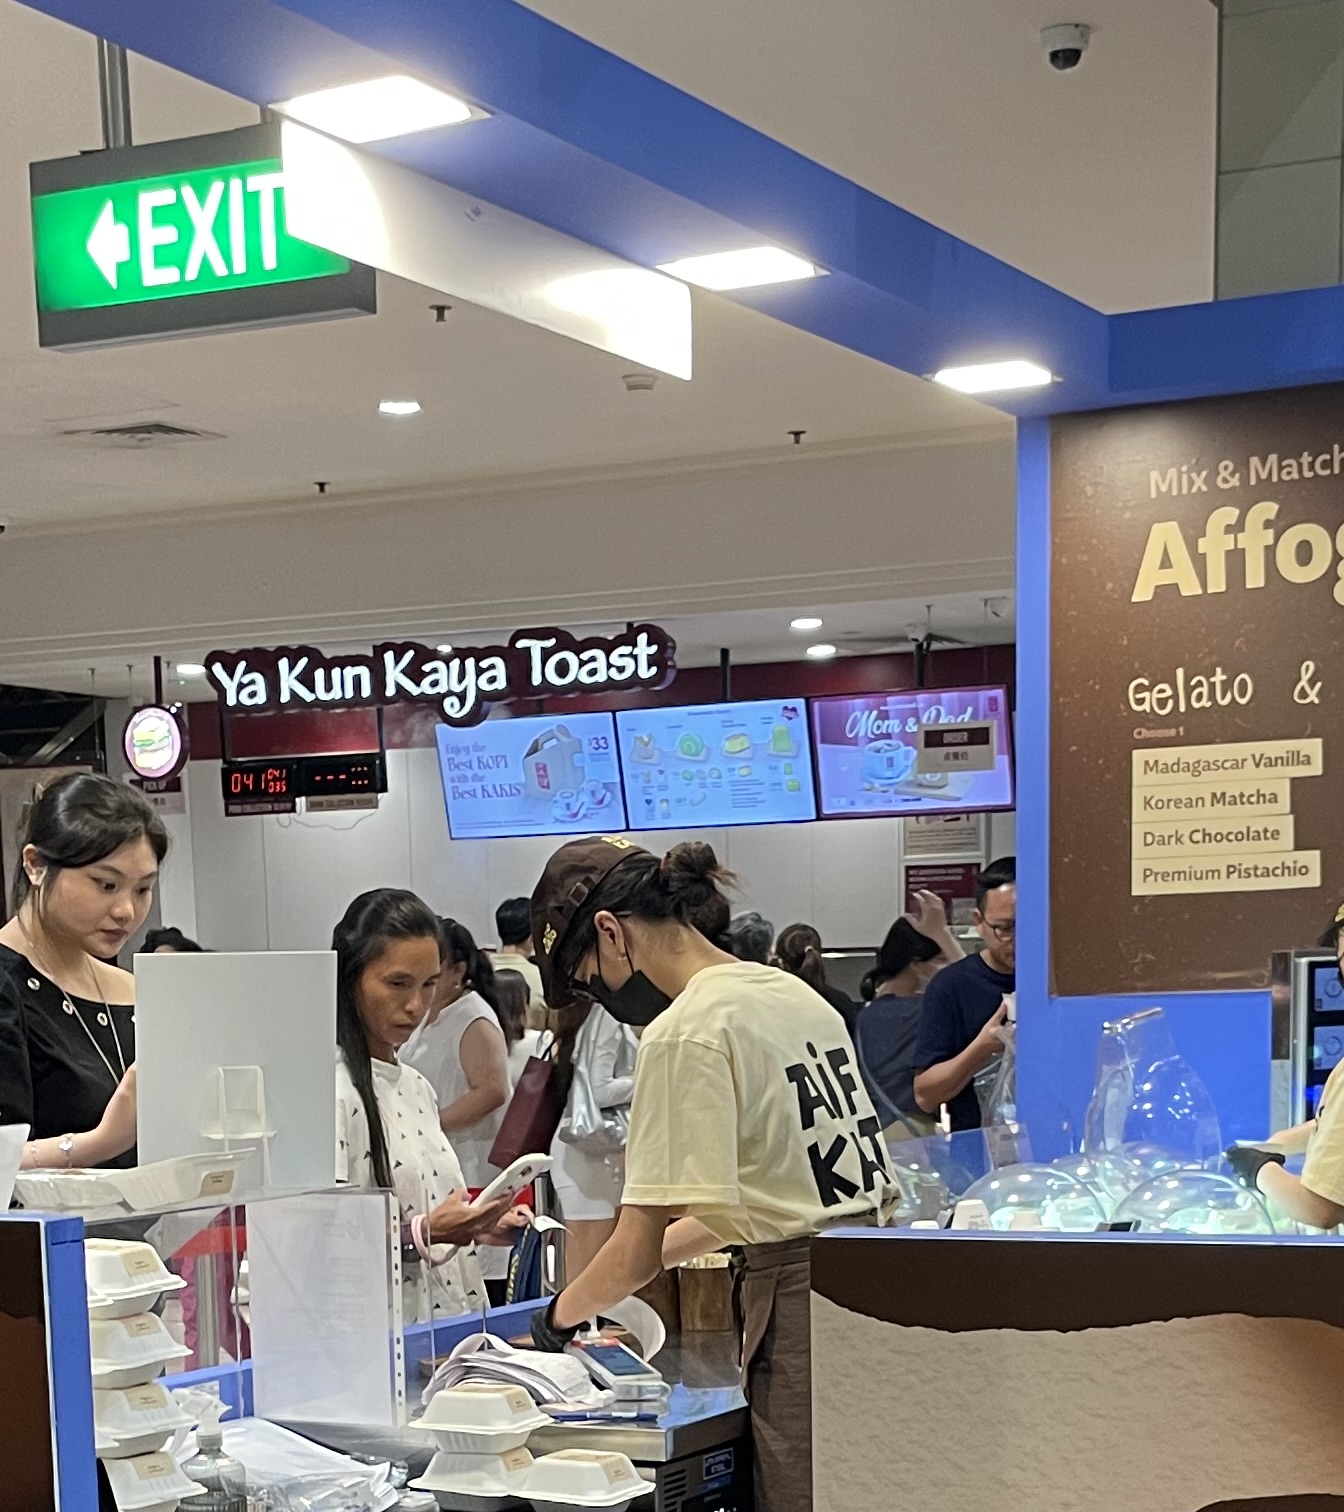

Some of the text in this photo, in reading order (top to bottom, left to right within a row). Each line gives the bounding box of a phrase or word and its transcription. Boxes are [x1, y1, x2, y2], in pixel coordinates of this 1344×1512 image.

[138, 172, 284, 288] EXIT
[1149, 466, 1207, 498] Mix
[1216, 461, 1240, 490] &
[213, 633, 658, 718] Ya Kun Kaya Toast
[1128, 666, 1253, 716] Gelato
[1293, 660, 1322, 704] &
[846, 710, 902, 738] Mom
[904, 716, 918, 733] &
[448, 755, 508, 771] Best KOPI
[1143, 750, 1311, 777] Madagascar Vanilla
[231, 774, 265, 793] 041
[452, 783, 521, 799] Best KAKIS
[1143, 789, 1278, 811] Korean Matcha
[1143, 826, 1280, 847] Dark Chocolate
[1143, 860, 1309, 883] Premium Pistachio
